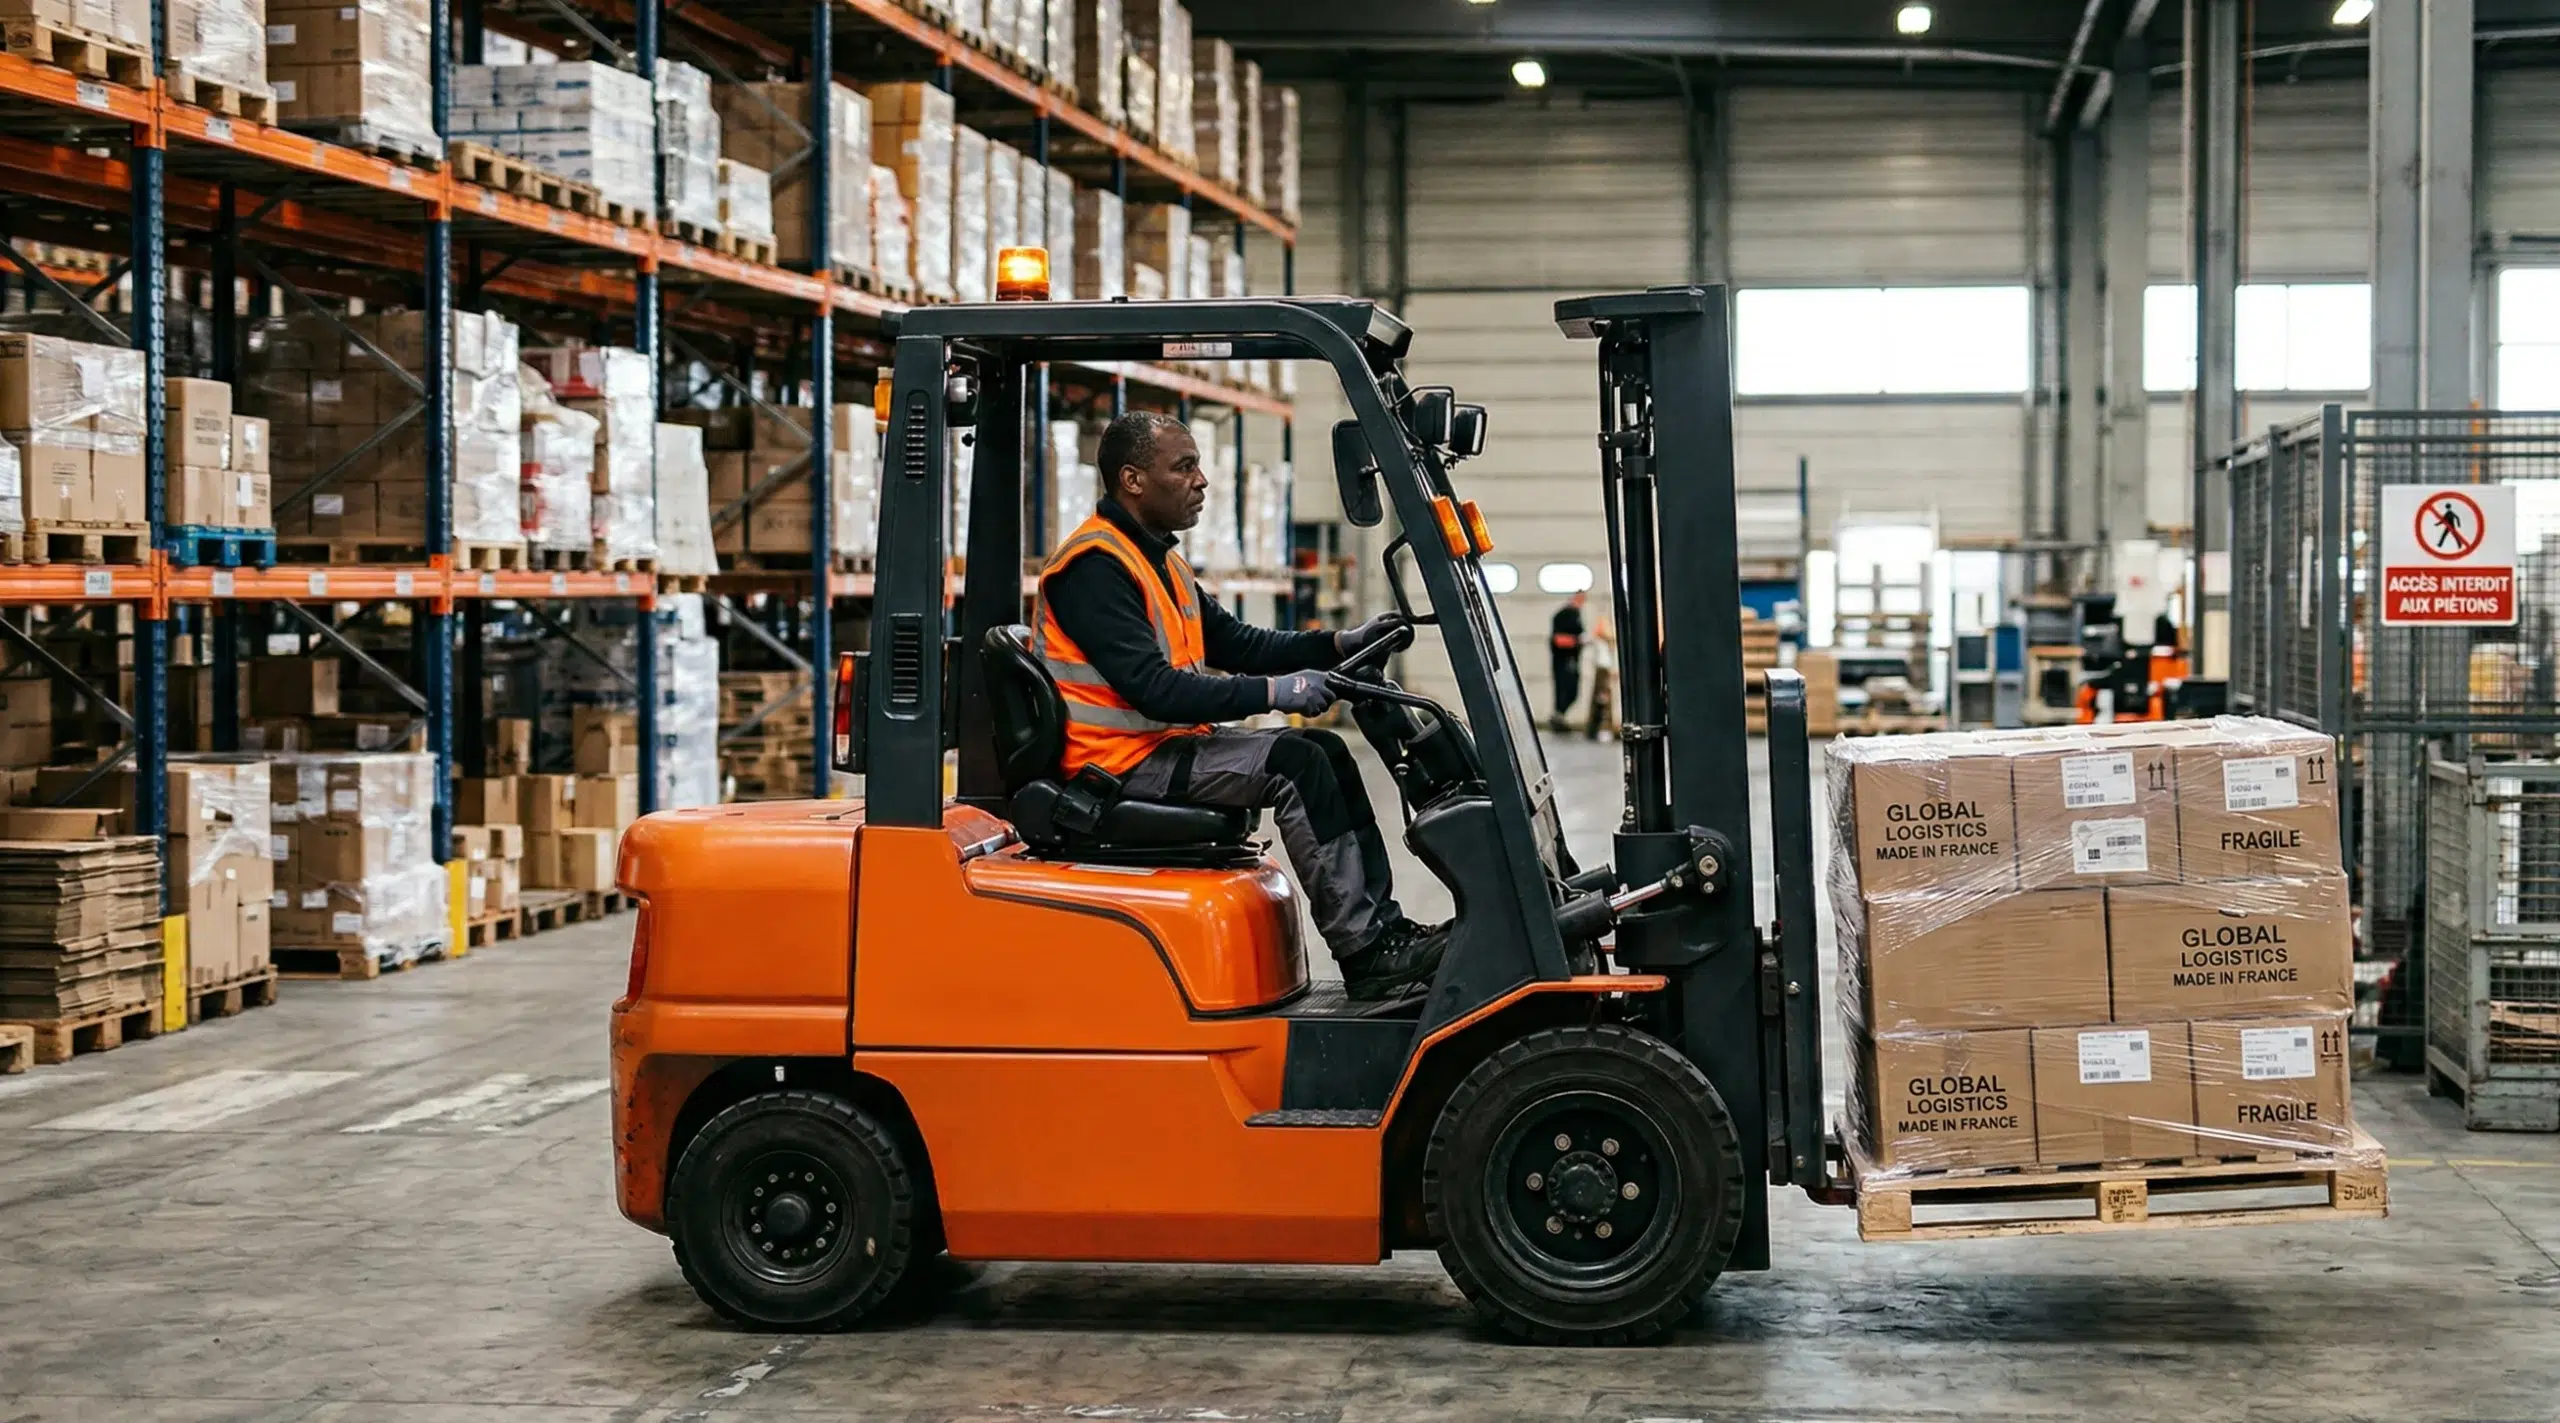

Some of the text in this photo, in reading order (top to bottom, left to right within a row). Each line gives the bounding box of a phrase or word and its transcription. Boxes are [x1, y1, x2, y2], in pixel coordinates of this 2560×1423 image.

[2389, 571, 2509, 592] ACCÈS INTERDIT
[2399, 593, 2499, 613] AUX PIÉTONS
[1886, 801, 1985, 822] GLOBAL
[1885, 822, 1988, 842] LOGISTICS
[2221, 829, 2301, 851] FRAGILE
[1876, 842, 1999, 860] MADE IN FRANCE
[2181, 925, 2287, 948] GLOBAL
[2181, 947, 2288, 968] LOGISTICS
[2173, 967, 2299, 987] MADE IN FRANCE
[1908, 1074, 2007, 1097] GLOBAL
[1907, 1095, 2009, 1115] LOGISTICS
[2237, 1102, 2318, 1124] FRAGILE
[1898, 1115, 2019, 1133] MADE IN FRANCE
